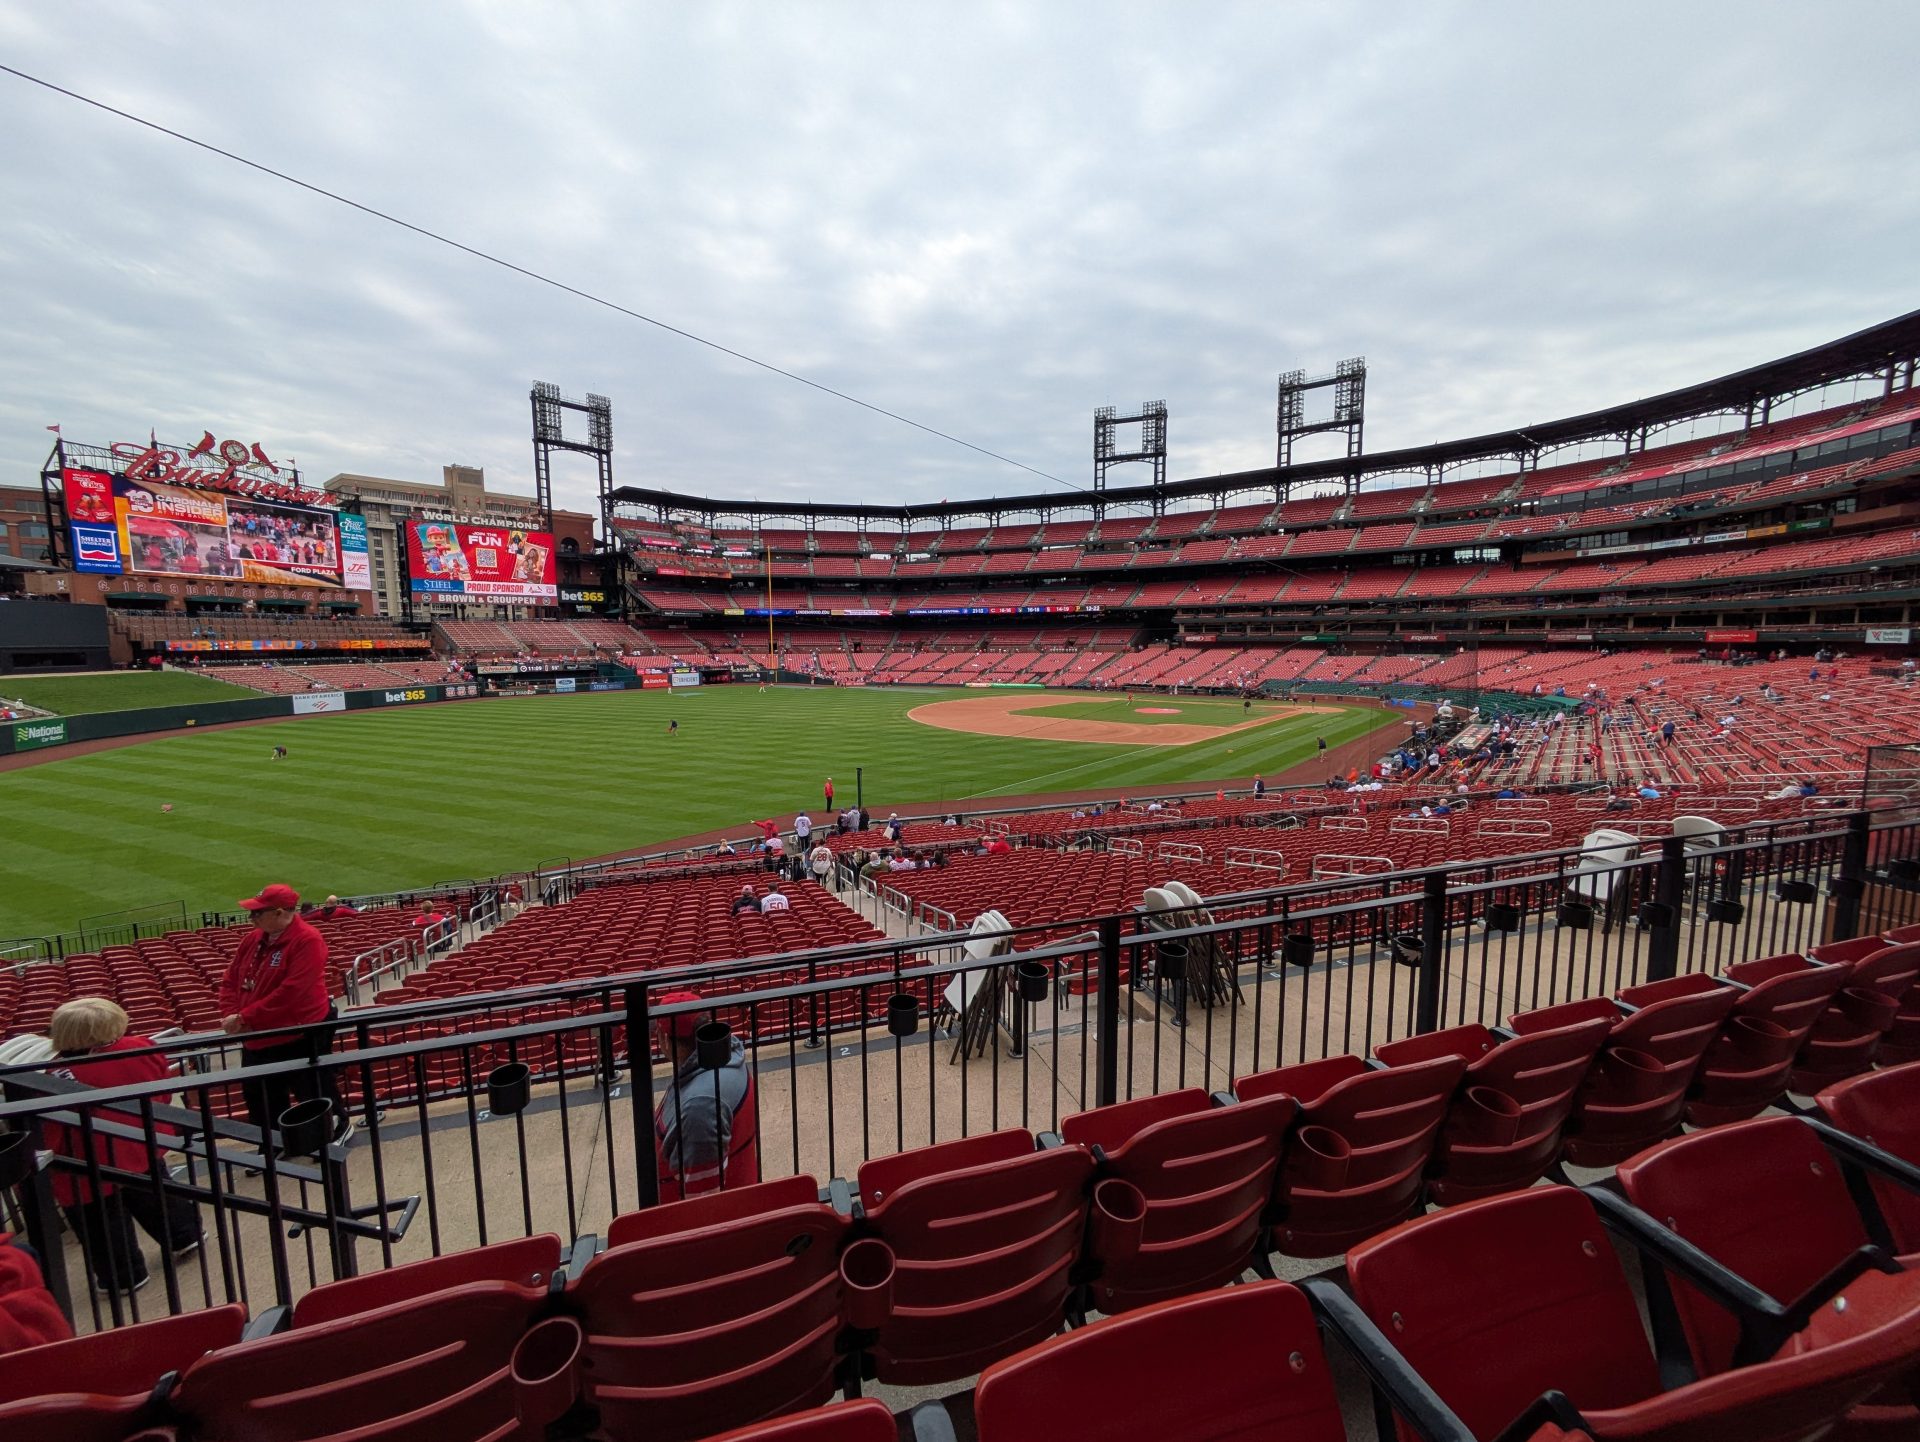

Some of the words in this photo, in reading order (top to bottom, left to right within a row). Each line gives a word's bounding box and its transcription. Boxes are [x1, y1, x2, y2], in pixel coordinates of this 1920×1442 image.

[111, 442, 338, 505] Budweiser
[155, 494, 223, 510] CARDINALS
[156, 501, 224, 518] INSIDER
[421, 510, 469, 524] WORLD
[470, 515, 541, 531] CHAMPIONS
[80, 535, 112, 545] SHELTER
[468, 534, 503, 548] FUN
[290, 566, 312, 575] FORD
[312, 568, 336, 576] PLAZA
[423, 579, 454, 589] STIFEL
[467, 582, 492, 592] PROUD
[491, 583, 525, 594] SPONSOR
[438, 593, 477, 604] BROWN
[486, 594, 536, 605] CROUPPEN
[561, 590, 605, 602] bet365
[385, 689, 426, 703] bet365
[28, 723, 64, 739] National
[839, 1047, 852, 1057] 2
